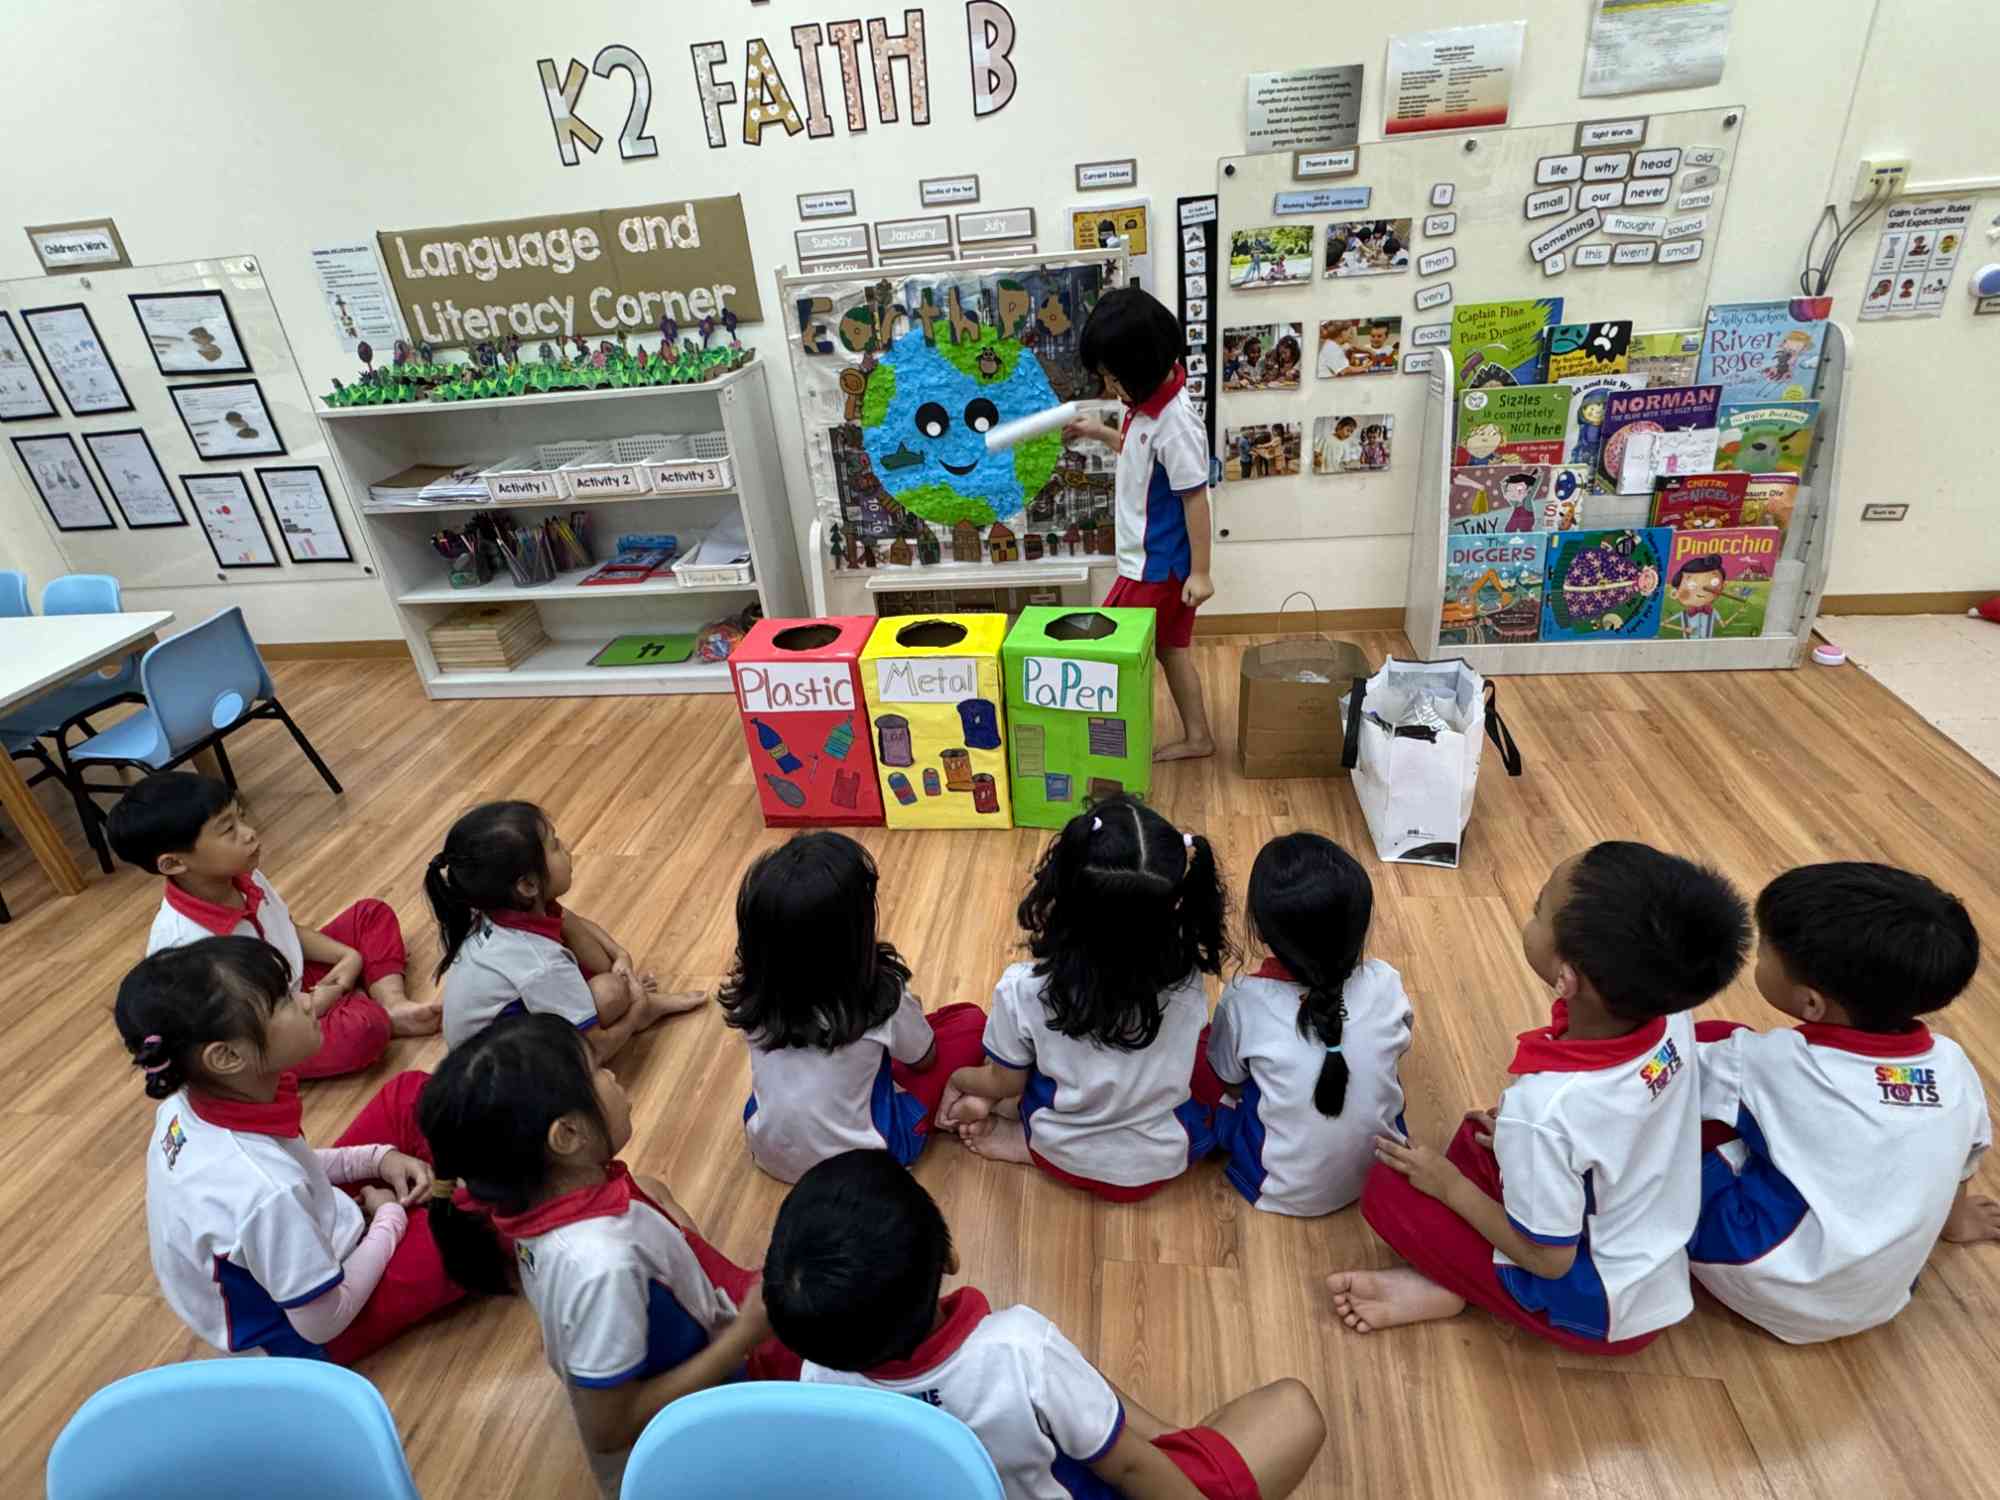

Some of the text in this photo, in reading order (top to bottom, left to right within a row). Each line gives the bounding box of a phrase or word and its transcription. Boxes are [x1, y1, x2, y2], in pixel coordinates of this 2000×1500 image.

[537, 0, 1017, 166] K2 FAITH B
[1306, 157, 1349, 168] Theme Board
[1594, 162, 1619, 174] why
[1640, 157, 1672, 170] head
[1083, 172, 1107, 181] Current
[1550, 164, 1568, 176] life
[1591, 192, 1611, 202] our
[1630, 188, 1664, 199] never
[1533, 196, 1563, 211] small
[1680, 195, 1711, 207] same
[1888, 204, 1971, 218] Calm Corner Rules
[1431, 218, 1449, 232] big
[1615, 219, 1656, 232] thought
[1667, 220, 1702, 236] sound
[1887, 215, 1965, 228] and Expectations
[889, 227, 936, 242] January
[1537, 217, 1595, 254] something
[395, 203, 700, 282] Language and
[811, 235, 853, 249] Sunday
[1584, 249, 1602, 259] this
[1620, 247, 1649, 258] went
[1665, 245, 1696, 257] small
[1423, 291, 1445, 303] very
[412, 284, 737, 345] Literacy Corner
[797, 285, 980, 354] Earth
[1457, 309, 1496, 326] Captain
[1419, 327, 1447, 339] each
[1711, 328, 1776, 354] River
[1583, 380, 1601, 390] and
[1602, 378, 1618, 386] his
[1498, 393, 1542, 408] Sizzles
[1611, 388, 1715, 416] NORMAN
[1494, 407, 1555, 421] completely
[1510, 422, 1562, 437] NOT here
[576, 474, 631, 489] Activity 2
[660, 469, 716, 485] Activity 3
[498, 480, 539, 493] Activity
[1675, 533, 1774, 561] Pinocchio
[1453, 547, 1538, 564] DIGGERS
[882, 659, 975, 698] Metal
[736, 666, 853, 711] Plastic
[1874, 1065, 1937, 1085] SPARKLE
[1876, 1082, 1940, 1103] TOTS
